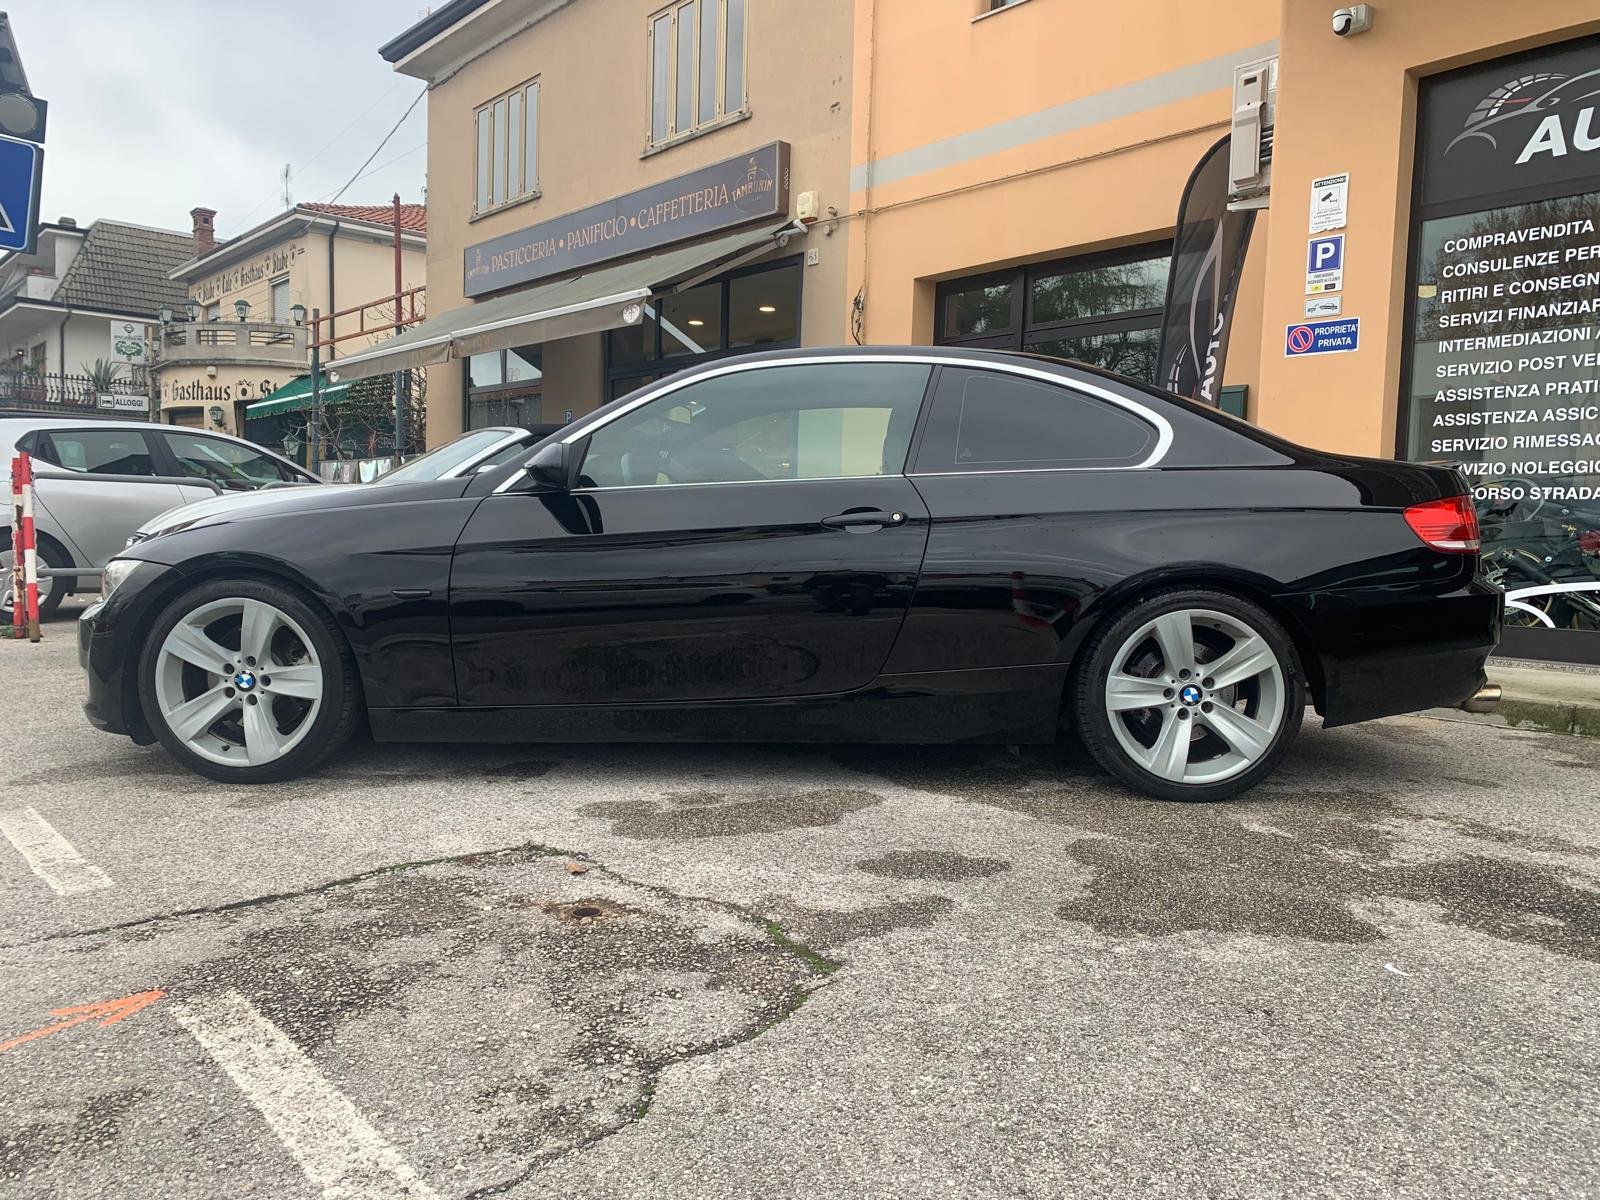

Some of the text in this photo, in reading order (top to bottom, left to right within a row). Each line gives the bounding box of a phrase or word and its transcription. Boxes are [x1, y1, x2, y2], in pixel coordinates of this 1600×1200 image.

[731, 179, 773, 202] TAMBURIN
[491, 183, 729, 272] PASTICCERIA PANIFICIO CAFFETTERIA
[1444, 219, 1594, 253] COMPRAVENDITA
[1316, 242, 1335, 269] P
[1442, 244, 1600, 278] CONSULENZE PER
[1441, 271, 1600, 303] RITIRI E CONSEGN
[1314, 323, 1358, 336] PROPRIETA'
[1439, 309, 1503, 328] SERVIZI
[1318, 337, 1352, 348] PRIVATA
[1438, 326, 1591, 353] INTERMEDIAZIONI
[1436, 353, 1600, 378] SERVIZIO POST VE
[172, 379, 231, 401] Gasthaus
[1434, 379, 1600, 402] ASSISTENZA PRATI
[115, 398, 143, 407] ALLOGGI
[1433, 406, 1599, 427] ASSISTENZA ASSIC
[1431, 436, 1508, 452] SERVIZIO
[1458, 461, 1506, 476] VIZIO
[1530, 486, 1600, 501] STRADA
